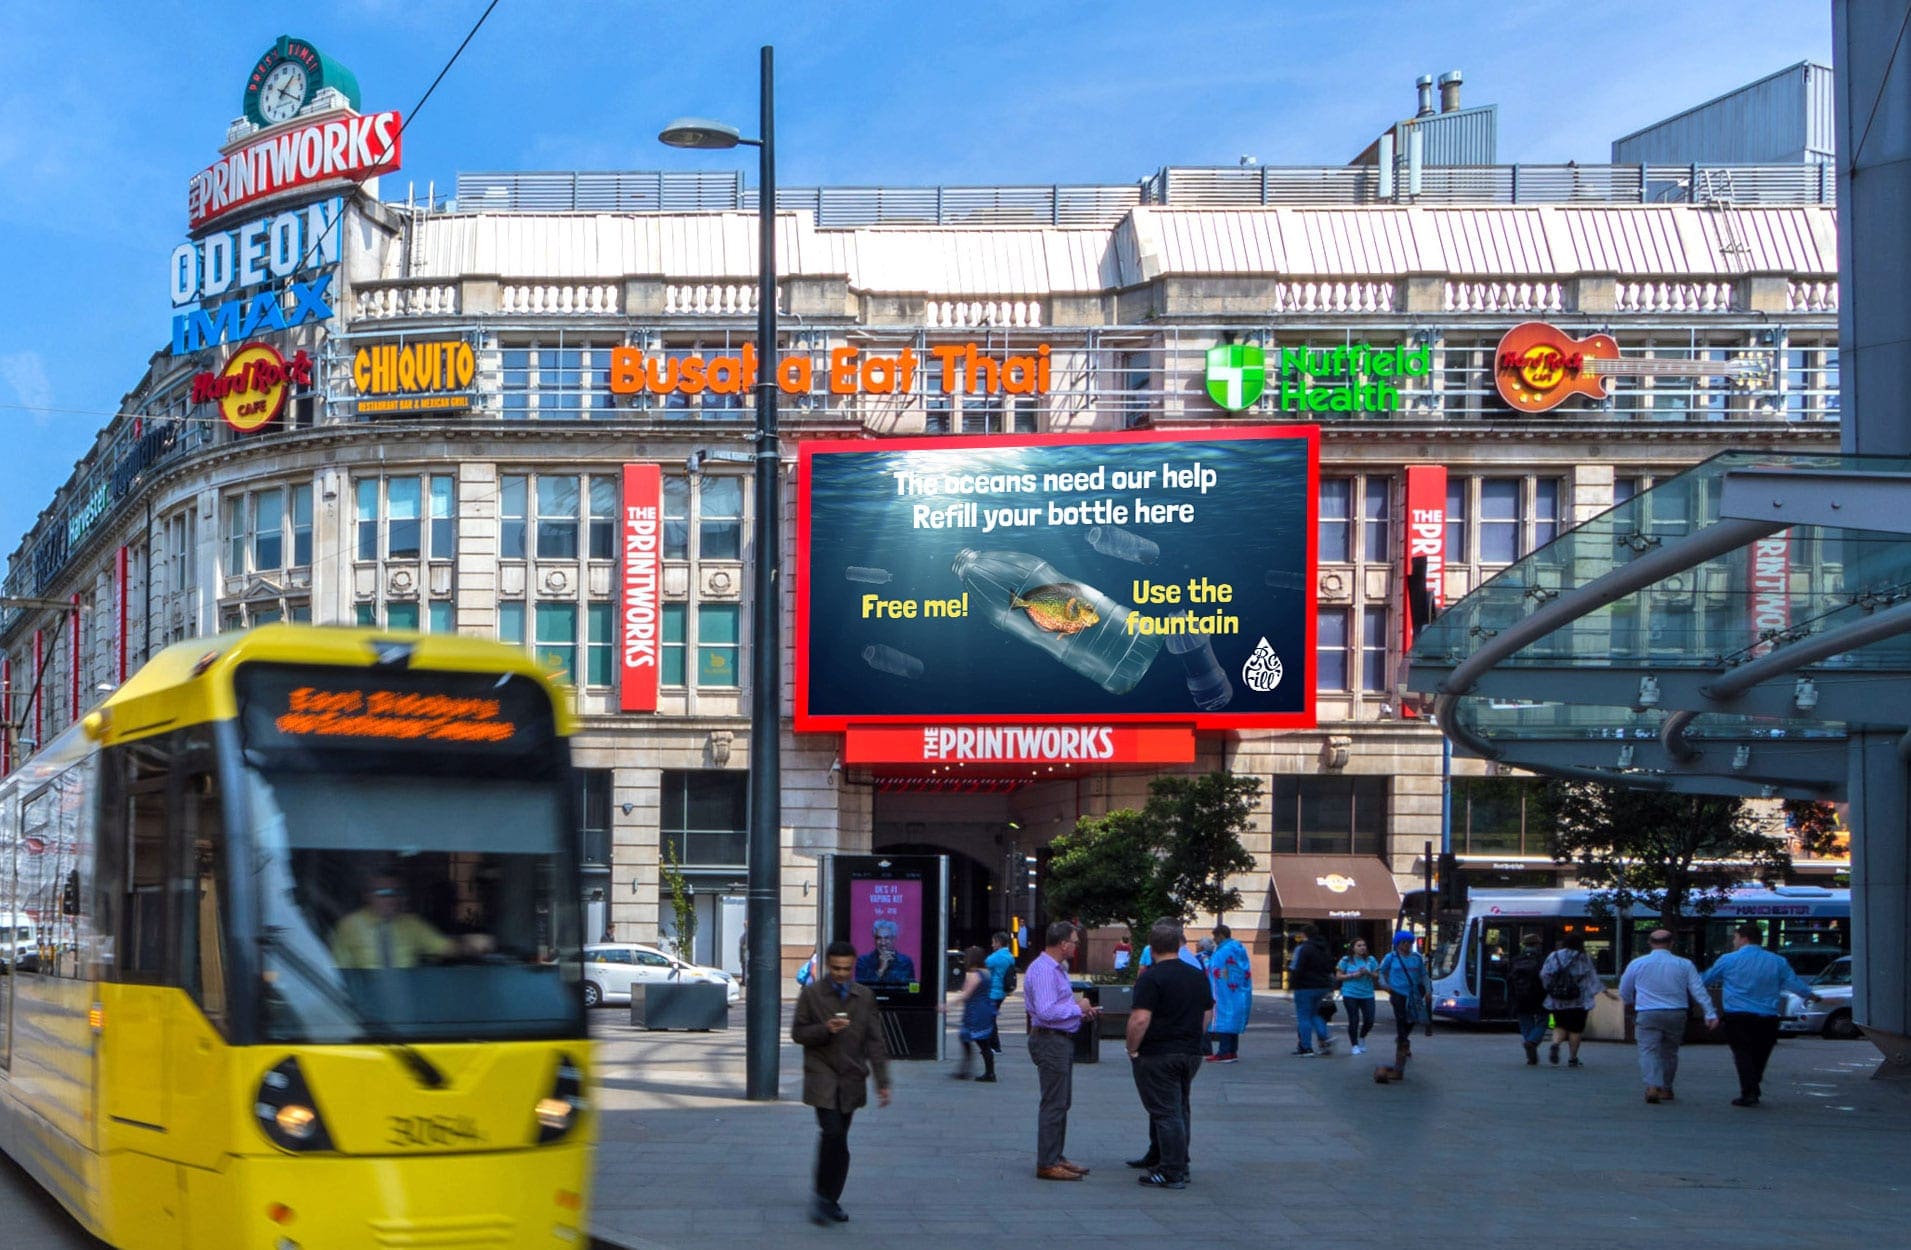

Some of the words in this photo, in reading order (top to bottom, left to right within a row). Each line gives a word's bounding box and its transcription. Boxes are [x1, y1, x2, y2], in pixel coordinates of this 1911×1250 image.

[200, 112, 395, 219] PRINTWORKS
[170, 196, 344, 307] ODEON
[172, 274, 334, 356] IMAX
[192, 363, 249, 404] Hard
[250, 350, 312, 396] Rock
[354, 340, 475, 394] CHIQUITO
[830, 346, 918, 395] Eat
[933, 342, 1051, 395] Thai
[1281, 343, 1430, 377] Nuffield
[1503, 352, 1544, 368] Hard
[237, 400, 267, 417] CAFE
[1281, 380, 1399, 412] Health
[893, 471, 938, 496] The
[944, 470, 1037, 495] oceans
[1043, 466, 1105, 493] need
[1111, 470, 1156, 490] our
[1162, 462, 1217, 495] help
[626, 506, 657, 519] THE
[913, 502, 977, 529] Refill
[982, 506, 1042, 533] your
[1048, 498, 1128, 525] bottle
[1135, 498, 1195, 524] here
[1412, 509, 1443, 522] THE
[1412, 523, 1443, 605] PRINT
[625, 520, 657, 669] PRINTWORKS
[861, 593, 918, 619] Free
[923, 591, 969, 618] me!
[1132, 579, 1182, 604] Use
[1187, 576, 1233, 603] the
[1125, 608, 1240, 636] fountain
[924, 727, 938, 759] THE
[939, 726, 1114, 759] PRINTWORKS
